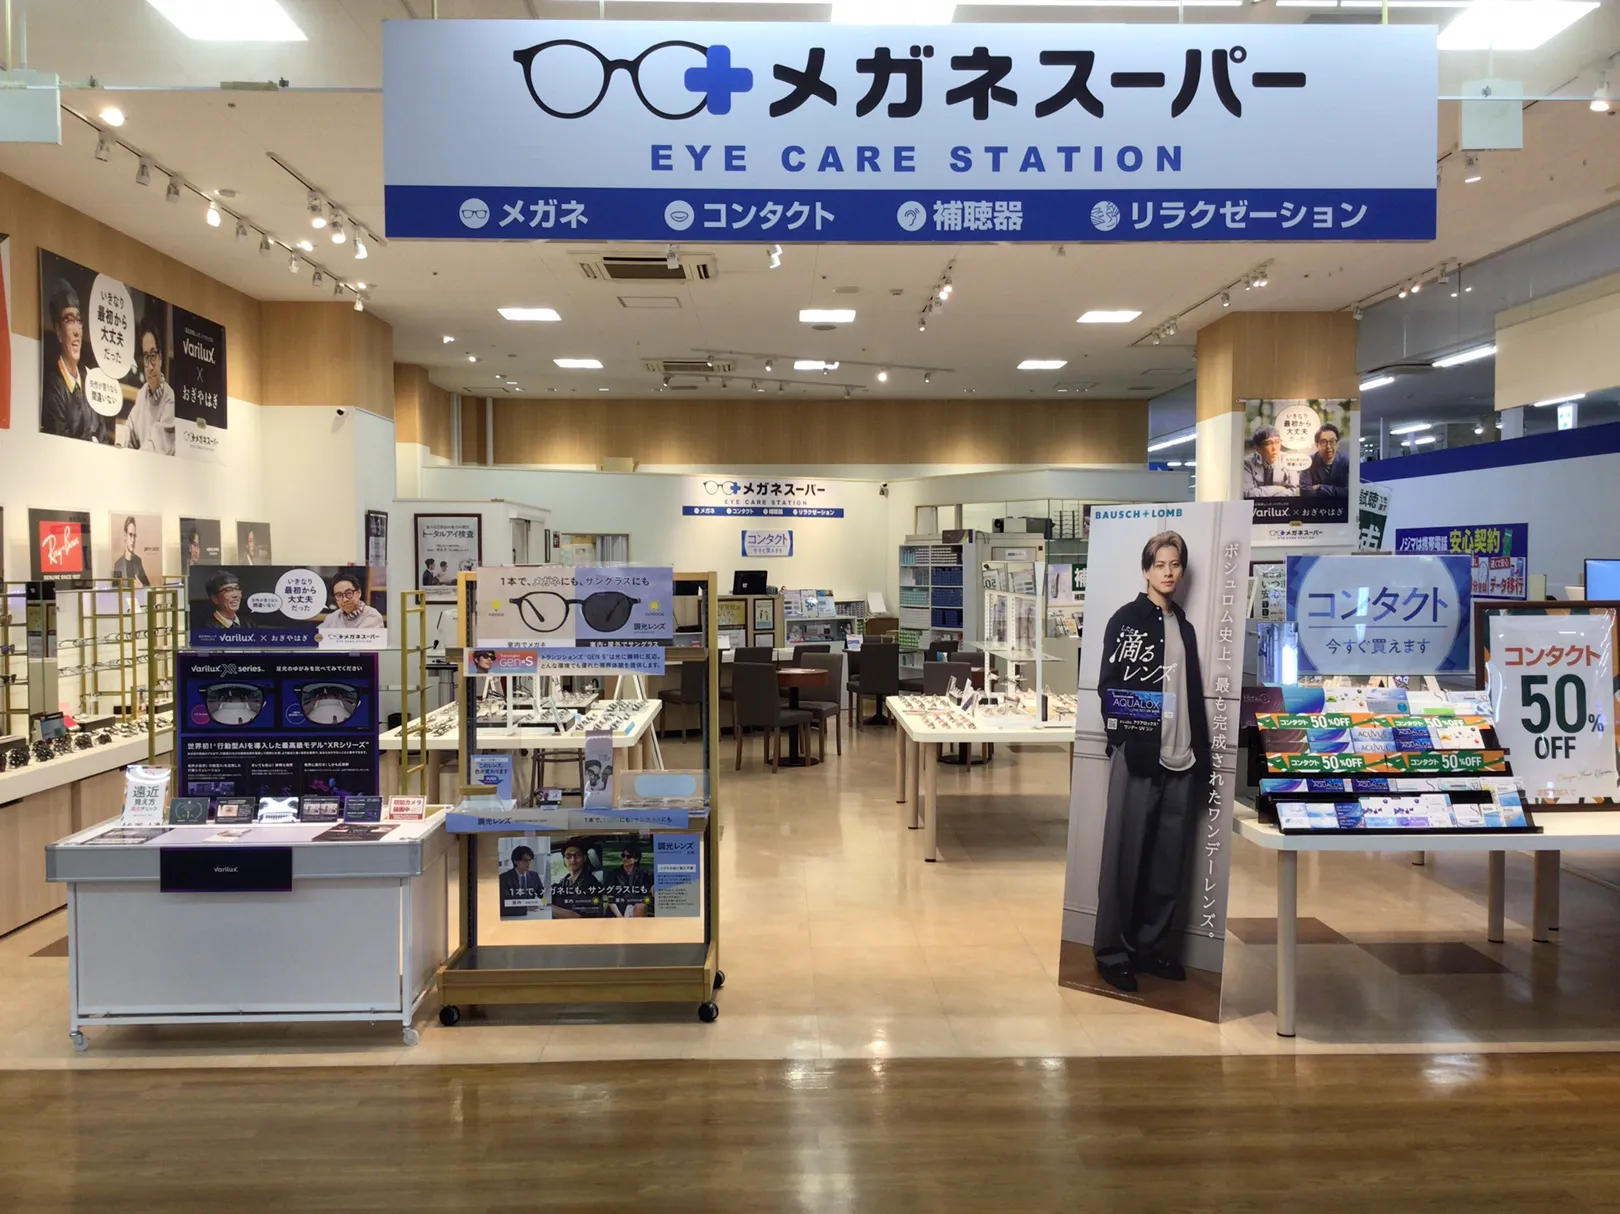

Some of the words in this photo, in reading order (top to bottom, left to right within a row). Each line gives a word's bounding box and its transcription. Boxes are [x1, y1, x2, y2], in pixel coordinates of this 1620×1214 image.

[769, 45, 1307, 120] メガネスーパー
[651, 144, 748, 172] EYE
[781, 145, 916, 173] CARE
[949, 145, 1183, 173] STATION
[499, 200, 589, 229] メガネ
[703, 202, 836, 231] コンタクト
[933, 201, 1024, 232] 補聴器
[1132, 202, 1368, 231] リラクゼーション
[100, 291, 125, 310] いきなり
[97, 304, 128, 330] 最初から
[100, 325, 124, 348] 大丈夫
[103, 348, 122, 364] だった
[182, 384, 219, 410] おぎやはぎ
[1283, 420, 1312, 428] 最初から
[743, 482, 826, 497] メガネスーパー
[798, 509, 835, 517] リラクゼーション
[1302, 507, 1344, 517] おぎやはぎ
[422, 530, 475, 539] トータルアイ検査
[748, 534, 788, 546] コンタクト
[1449, 527, 1501, 554] 安心契約
[287, 577, 313, 585] いきなり
[500, 576, 650, 587] 1本で、メガネにも、サングラスにも
[1490, 577, 1524, 594] データ移行
[284, 586, 317, 595] 最初から
[287, 595, 314, 604] 大丈夫
[1307, 586, 1449, 623] コンタクト
[291, 604, 311, 612] だった
[633, 622, 666, 631] 調光レンズ
[219, 634, 256, 642] Varilux
[270, 633, 308, 642] おぎやはぎ
[1108, 629, 1155, 664] 滴る
[1325, 637, 1431, 655] 今すぐ買えます
[1504, 644, 1601, 667] コンタクト
[238, 665, 261, 673] series
[1122, 662, 1179, 684] レンズ
[1112, 698, 1160, 709] AQUALOX
[1280, 718, 1309, 727] コンタクト
[1311, 715, 1351, 729] 50%OFF
[1394, 719, 1424, 727] コンタクト
[1358, 729, 1388, 738] ACUVUE
[1199, 542, 1240, 940] ボシュロム史上、最も完成されたワンデーレンズ。
[1534, 735, 1577, 760] OFF
[1291, 758, 1320, 767] コンタクト
[1321, 754, 1363, 770] 50%OFF
[1410, 758, 1440, 767] コンタクト
[1441, 753, 1482, 769] 50%OFF
[132, 785, 160, 798] 遠近
[134, 798, 155, 806] 見え方
[477, 817, 512, 826] 調光レンズ
[657, 842, 695, 851] 調光レンズ
